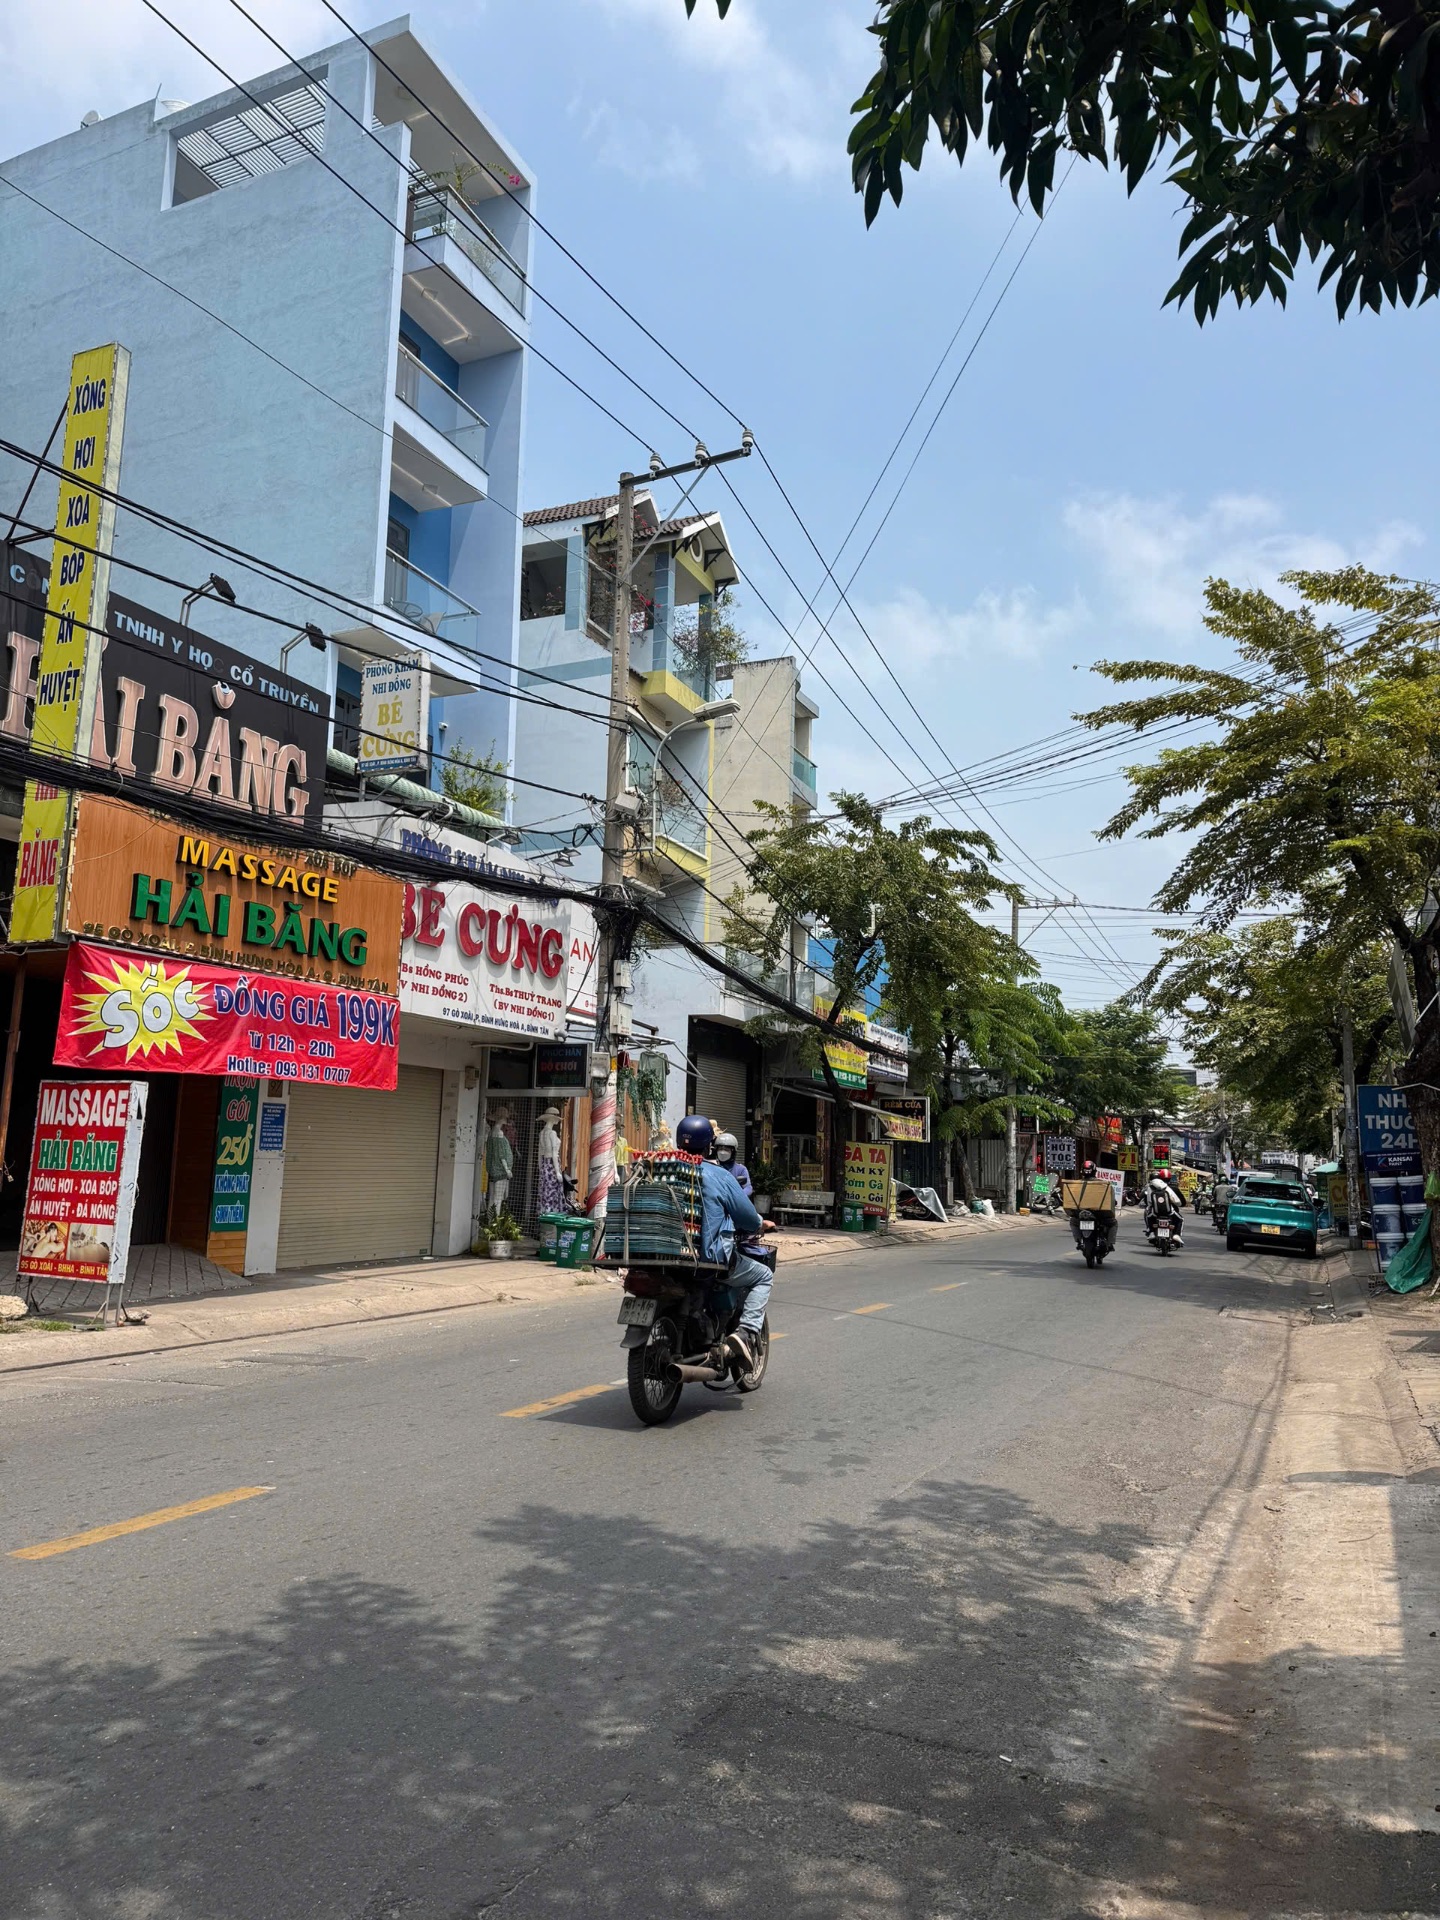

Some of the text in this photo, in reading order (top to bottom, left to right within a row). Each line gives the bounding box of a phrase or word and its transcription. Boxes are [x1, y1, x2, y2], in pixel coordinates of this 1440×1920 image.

[73, 375, 107, 416] XÔNG
[73, 436, 96, 470] HƠI
[66, 493, 90, 528] XOA
[60, 545, 85, 587] BÓP
[56, 599, 76, 645] ẤN
[114, 610, 165, 648] TNHH
[171, 636, 184, 654] Y
[230, 664, 254, 687] CỔ
[258, 676, 319, 714] TRUYỀN
[38, 661, 81, 712] HUYỆT
[372, 675, 411, 695] NHI ĐỒNG
[377, 695, 403, 726] BÉ
[362, 728, 417, 758] CƯNG
[19, 828, 59, 888] BĂNG
[177, 835, 340, 903] MASSAGE
[130, 872, 368, 966] HẢI BĂNG
[402, 879, 446, 948] BÉ
[457, 902, 564, 978] CƯNG
[82, 920, 104, 938] 95
[107, 925, 134, 943] GÒ
[200, 942, 234, 961] BÌNH
[236, 952, 274, 968] HƯNG
[275, 958, 303, 976] HÒA
[367, 978, 389, 993] TÂN
[415, 964, 442, 980] HỒNG
[445, 973, 469, 987] PHÚC
[100, 963, 398, 1049] SỐC ĐỒNG GIÁ 199K
[411, 982, 429, 995] NHI
[432, 985, 457, 1002] ĐỒNG
[537, 995, 562, 1009] TRANG
[442, 1007, 451, 1016] 97
[451, 1008, 460, 1018] GÒ
[481, 1013, 494, 1025] BÌNH
[509, 1018, 520, 1030] HOÀ
[540, 1025, 549, 1036] TÂN
[510, 1005, 525, 1016] NHI
[267, 1034, 295, 1053] 12h
[308, 1040, 335, 1058] 20h
[275, 1061, 297, 1077] 093
[301, 1064, 320, 1080] 131
[324, 1067, 352, 1083] 0707
[40, 1088, 129, 1127] MASSAGE
[226, 1095, 250, 1122] GÓI
[1378, 1093, 1410, 1108] NH
[38, 1130, 119, 1172] HẢI BĂNG
[869, 1148, 887, 1165] TA
[1119, 1152, 1136, 1165] 71
[33, 1173, 57, 1192] XÔNG
[58, 1179, 74, 1194] HƠI
[79, 1179, 98, 1195] XOA
[99, 1176, 118, 1196] BÓP
[843, 1190, 860, 1200] háo
[868, 1192, 884, 1203] Gỏi
[869, 1180, 883, 1190] Gà
[29, 1195, 41, 1215] ẤN
[42, 1198, 71, 1221] HUYỆT
[76, 1199, 89, 1218] ĐÁ
[90, 1201, 115, 1220] NÓNG
[20, 1259, 29, 1269] 95
[29, 1259, 38, 1270] GÒ
[57, 1263, 75, 1274] BHHA
[80, 1262, 95, 1275] BÌNH
[96, 1263, 109, 1277] TÂN
